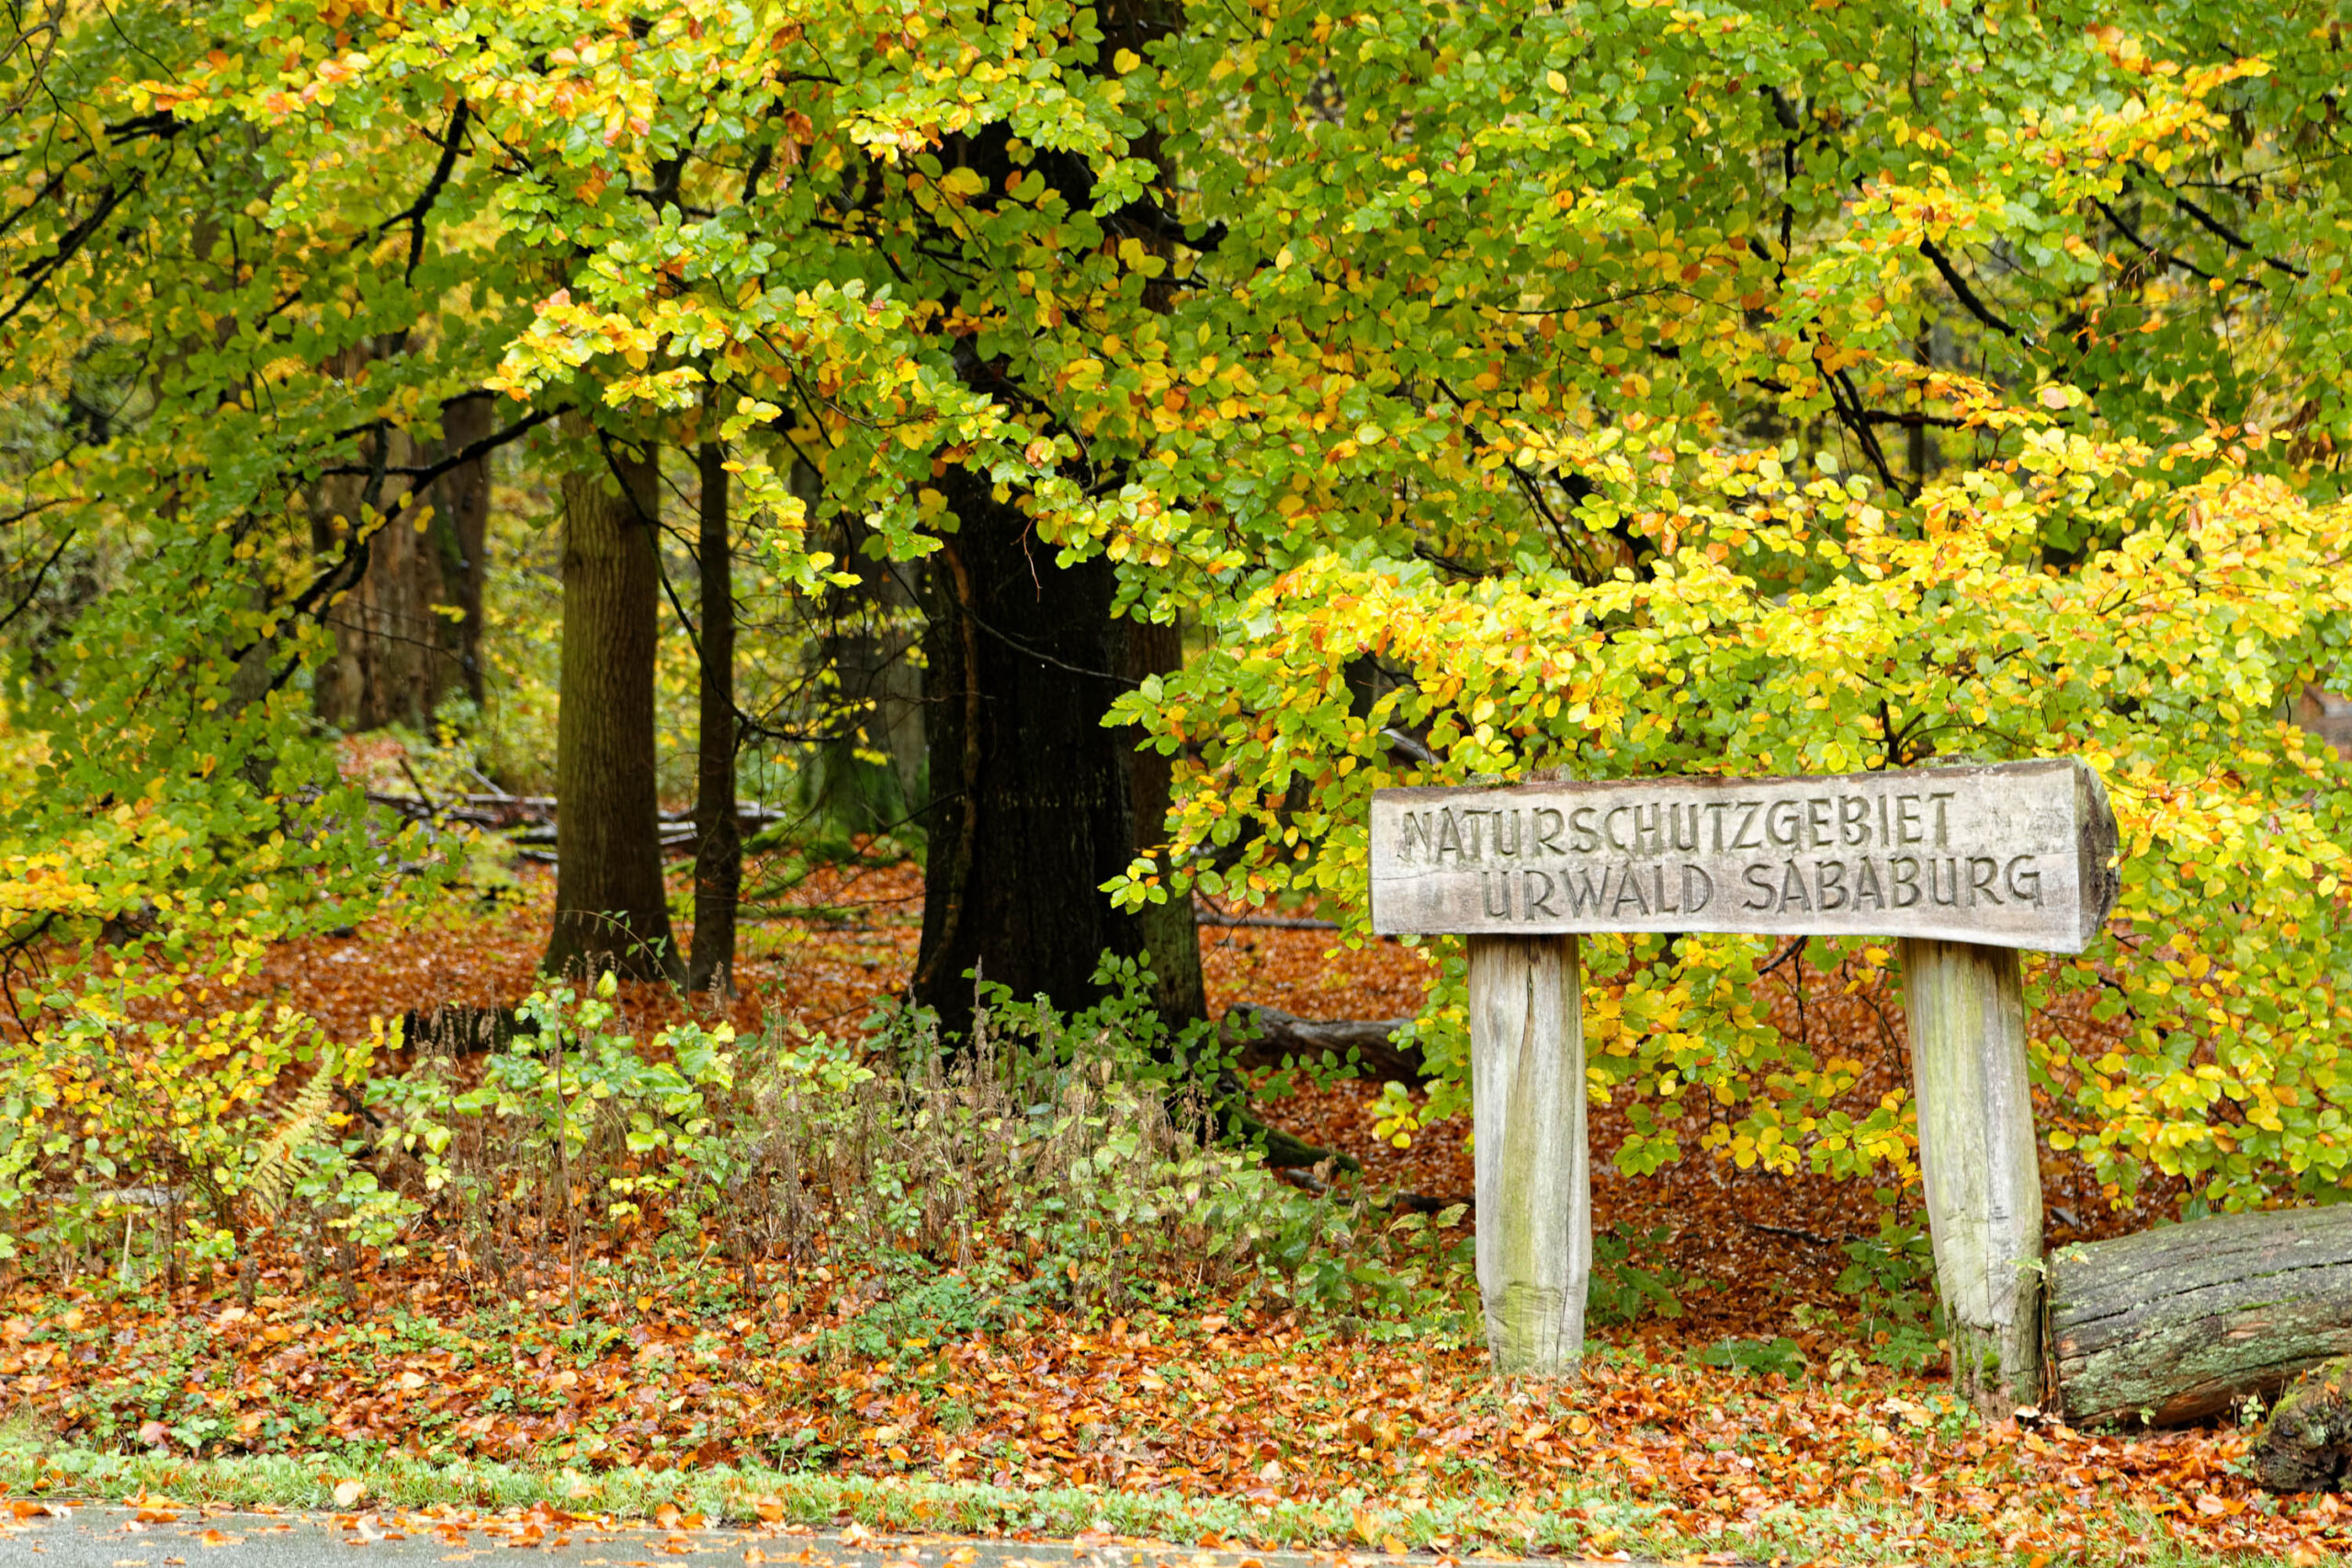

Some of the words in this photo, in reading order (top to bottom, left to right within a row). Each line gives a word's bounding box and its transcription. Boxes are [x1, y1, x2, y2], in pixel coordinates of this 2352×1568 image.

[1402, 792, 1956, 863] NATURSCHUTZGEBIET
[1482, 863, 1714, 921] URWALD
[1742, 853, 2045, 915] SABABURG
